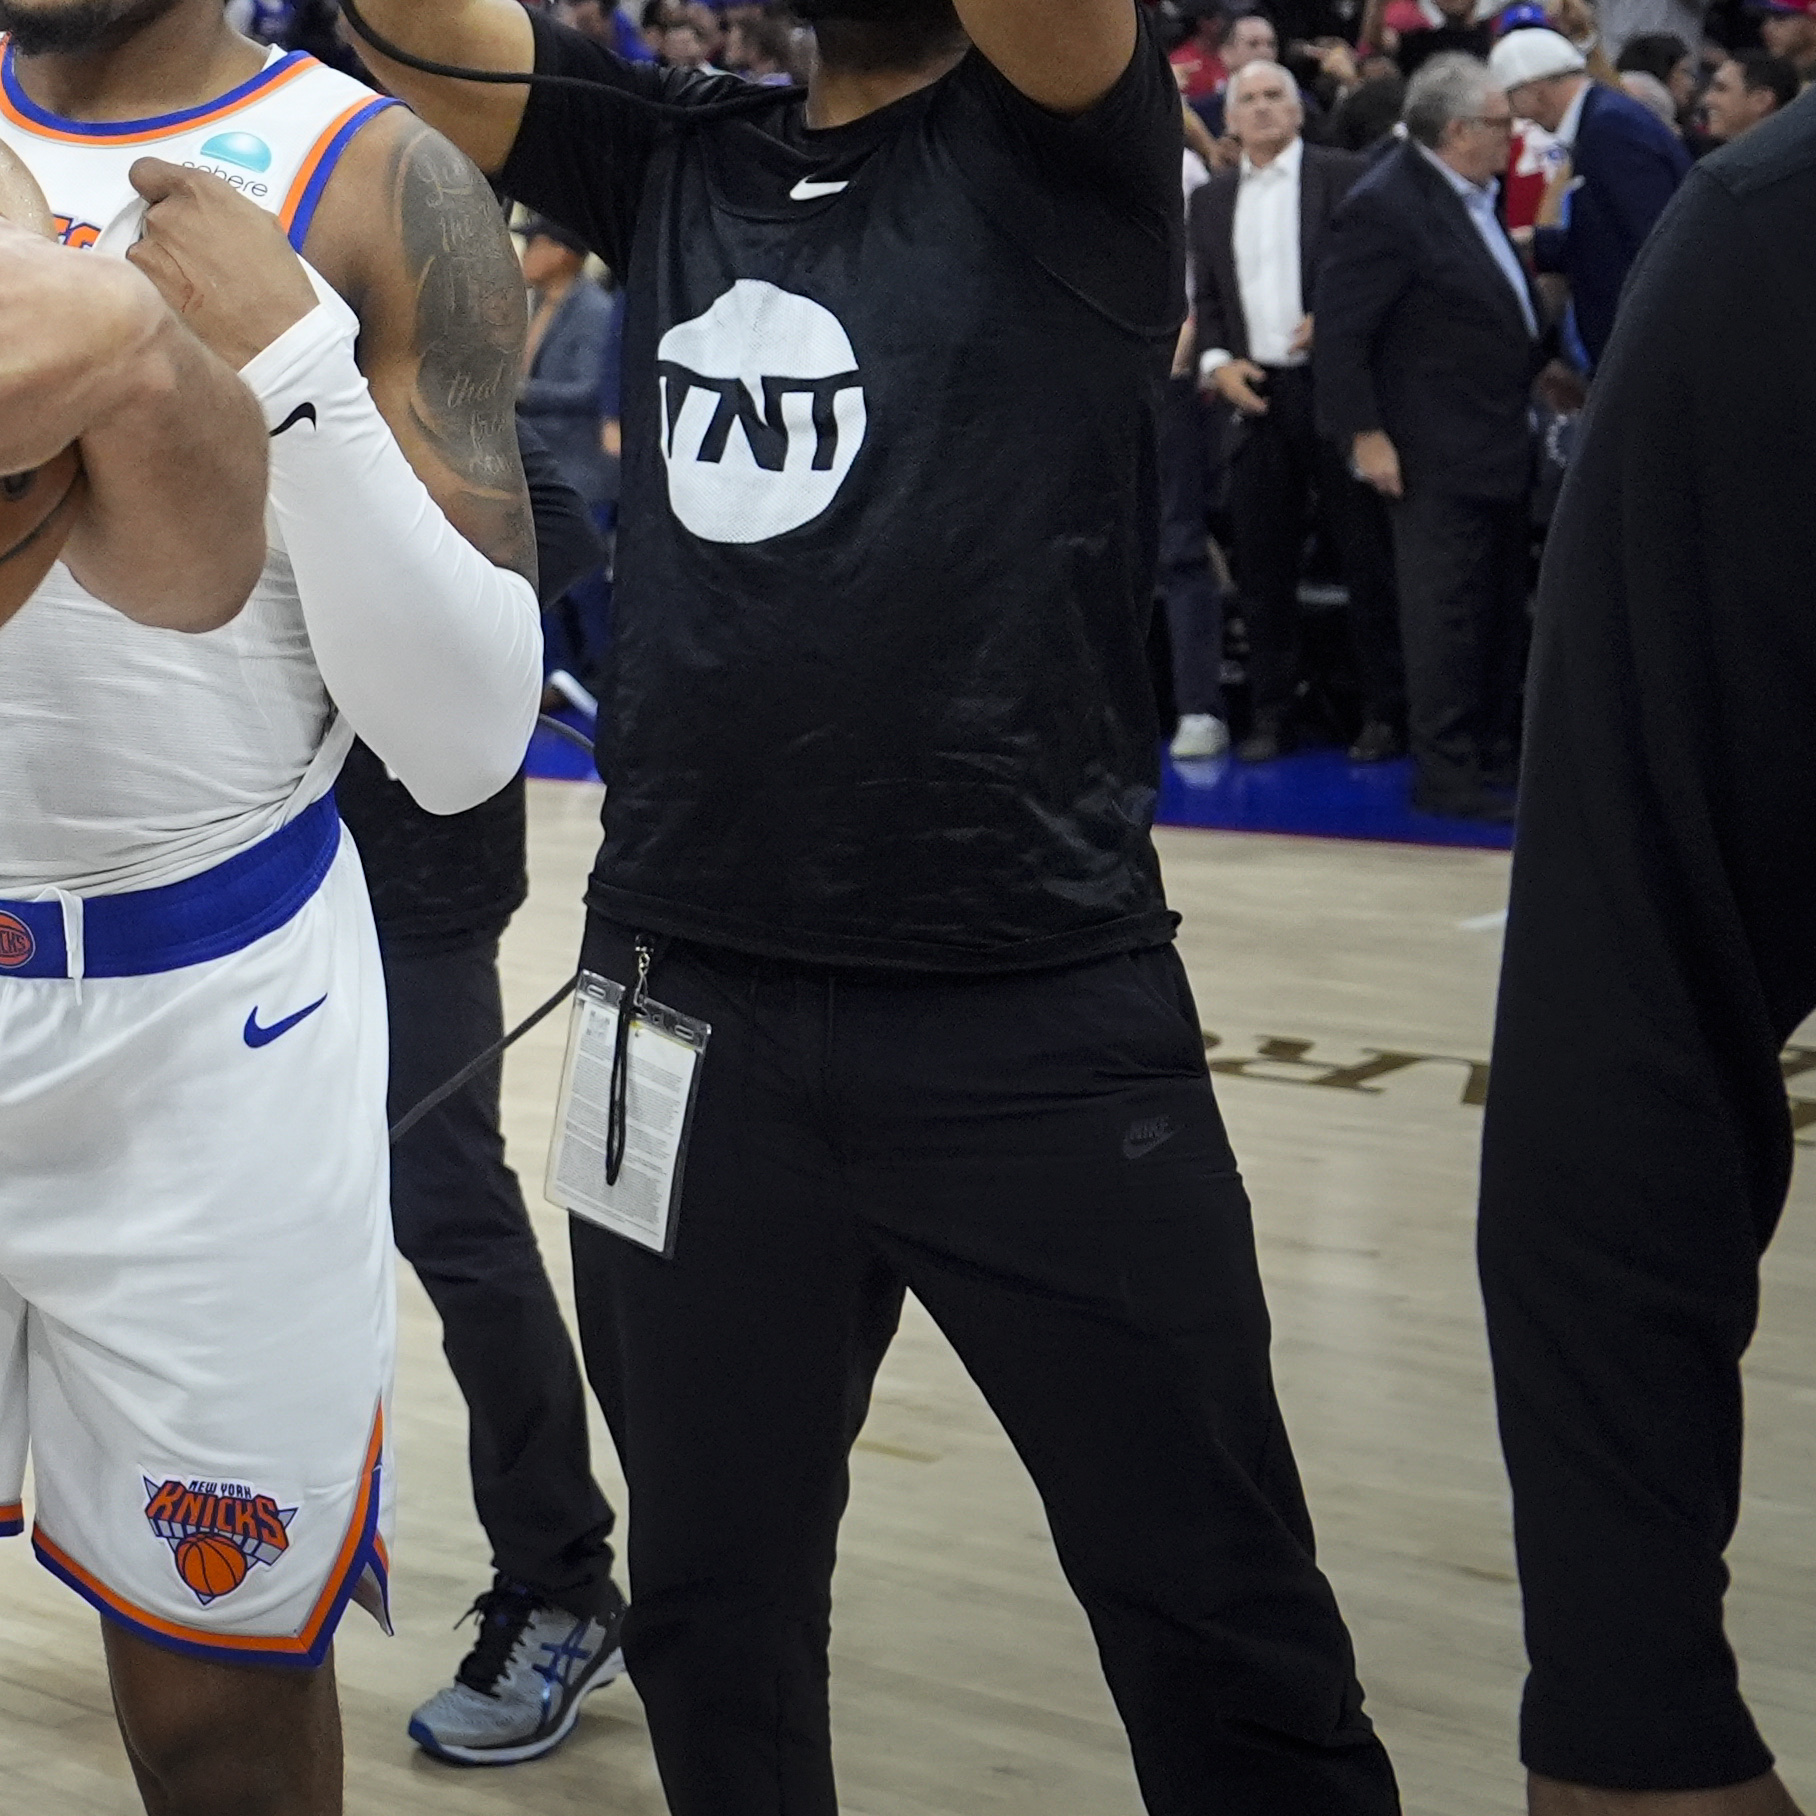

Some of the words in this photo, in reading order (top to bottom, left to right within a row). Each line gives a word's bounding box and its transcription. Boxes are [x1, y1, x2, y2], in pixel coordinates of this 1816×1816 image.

[657, 358, 866, 473] TNT
[144, 1480, 290, 1552] KNICKS
[188, 1479, 218, 1494] NEW
[220, 1482, 253, 1500] YORK
